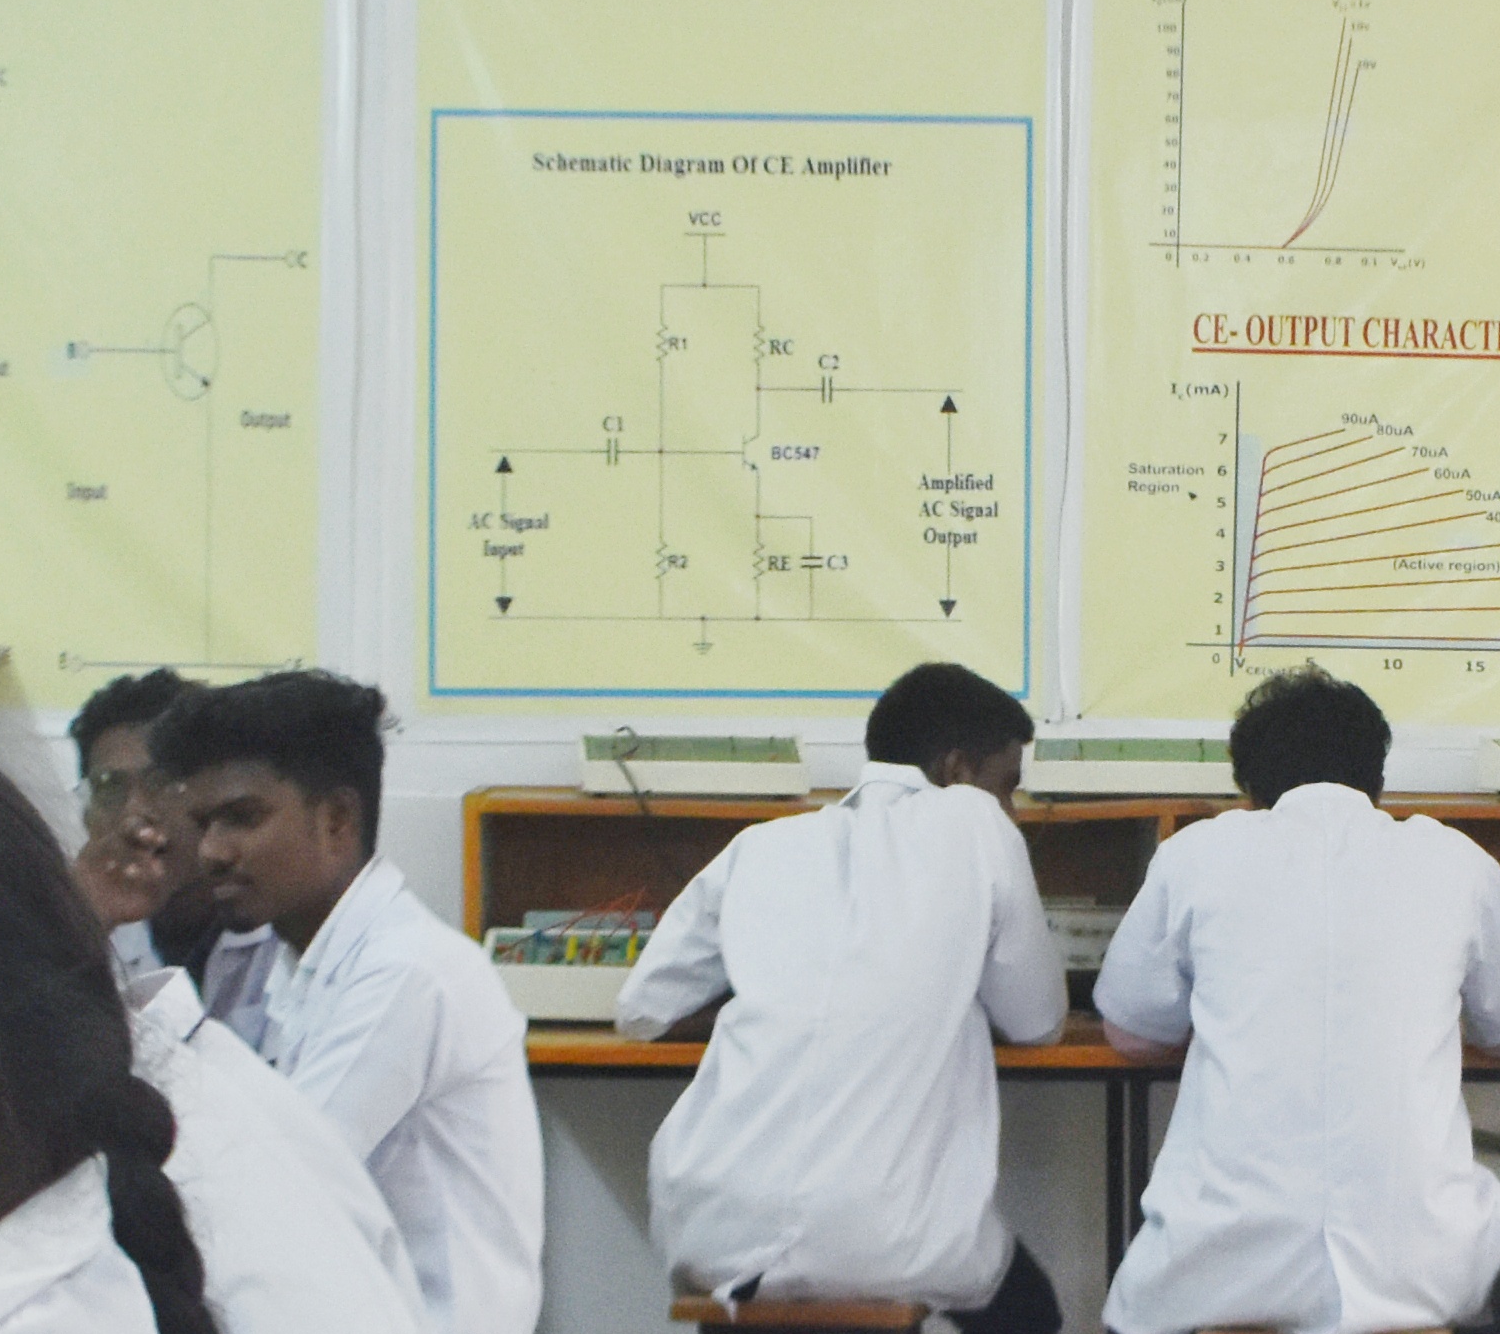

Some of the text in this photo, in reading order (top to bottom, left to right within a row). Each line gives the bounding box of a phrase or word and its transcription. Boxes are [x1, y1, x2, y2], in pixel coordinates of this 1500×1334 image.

[532, 152, 892, 181] Schematic Diagram Of CE Amplifier
[688, 212, 722, 227] VCC
[1192, 312, 1239, 345] CE-
[1245, 314, 1355, 349] OUTPUT
[668, 337, 688, 350] R1
[768, 339, 794, 356] RC
[818, 354, 840, 370] C2
[602, 415, 624, 432] C1
[1376, 424, 1414, 436] 80uA
[1218, 434, 1228, 445] 7
[771, 446, 820, 460] BC547
[1411, 446, 1449, 458] 70uA
[1128, 463, 1205, 477] Saturation
[1217, 466, 1228, 477] 6
[1434, 468, 1471, 480] 60uA
[918, 473, 994, 494] Amplified
[1128, 481, 1180, 495] Region
[1217, 497, 1226, 508] 5
[918, 501, 998, 522] AC Signal
[468, 513, 493, 529] AC
[923, 527, 978, 548] Output
[1216, 528, 1226, 539] 4
[768, 555, 792, 571] RE
[826, 555, 848, 570] C3
[1215, 561, 1225, 572] 3
[1393, 558, 1500, 575] (Active region)
[1214, 592, 1223, 604] 2
[1215, 624, 1222, 636] 1
[1383, 658, 1403, 670] 10
[1465, 661, 1485, 672] 15
